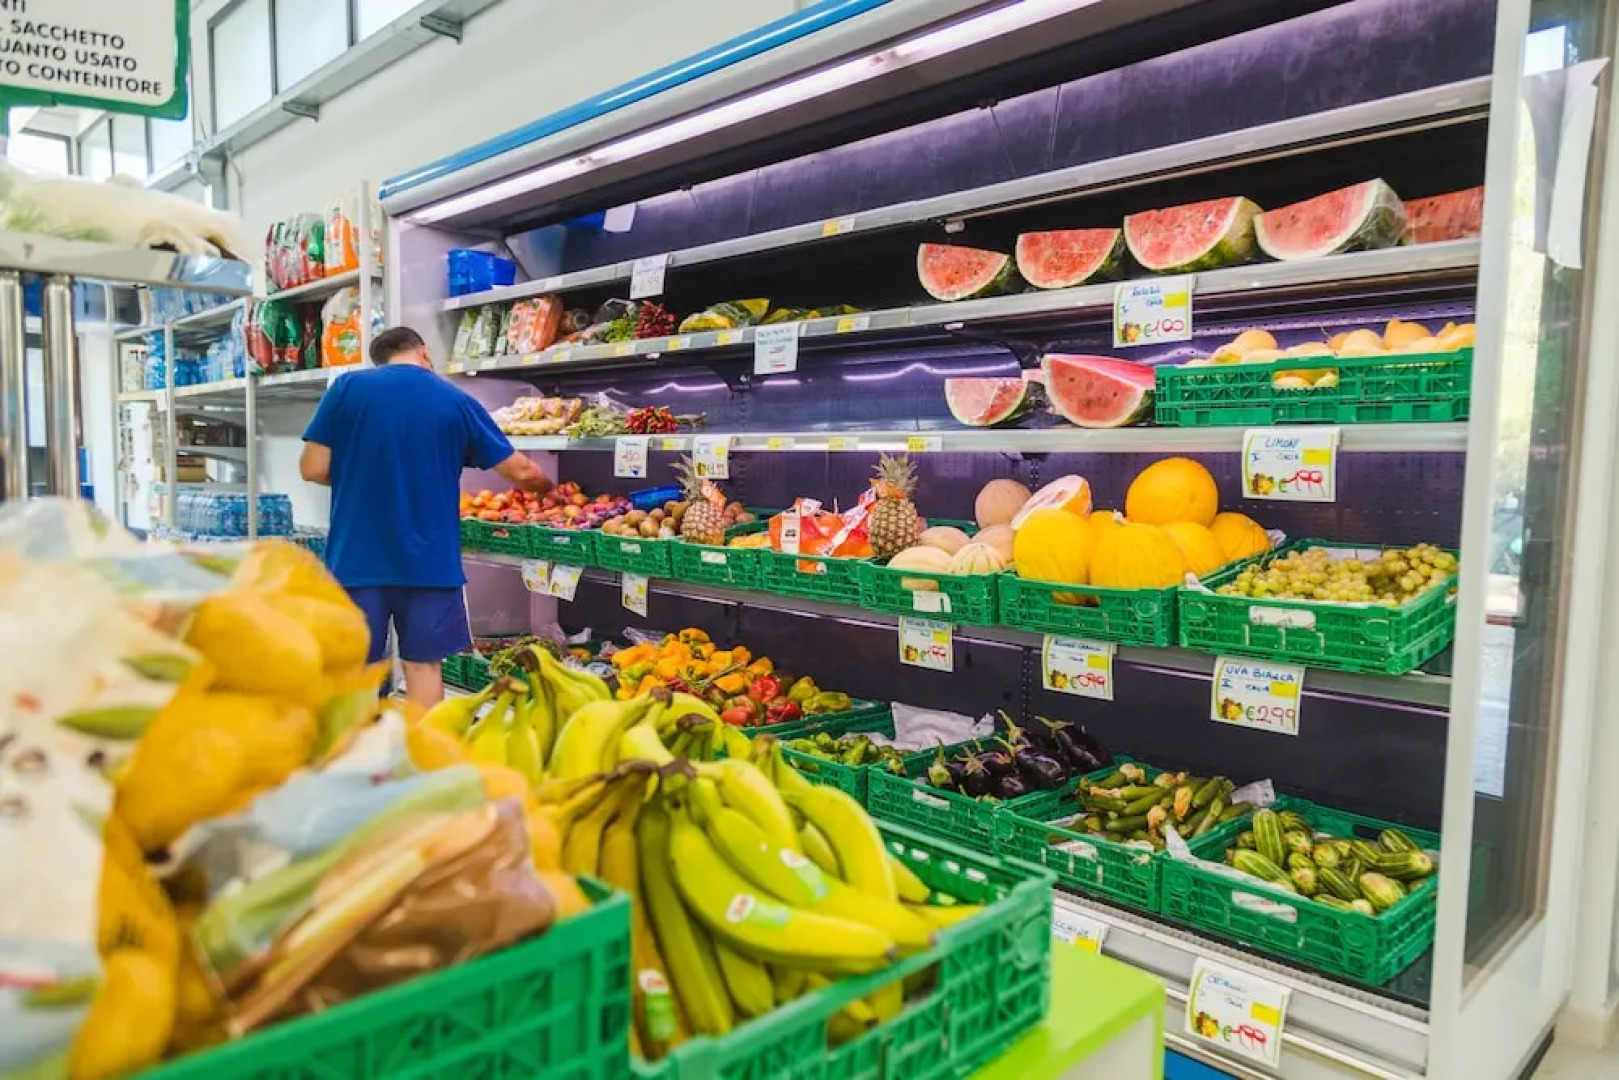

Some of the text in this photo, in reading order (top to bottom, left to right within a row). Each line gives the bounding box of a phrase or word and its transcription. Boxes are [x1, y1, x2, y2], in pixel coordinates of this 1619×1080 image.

[11, 18, 125, 50] SACCHETTO
[75, 50, 137, 72] USATO
[27, 63, 163, 97] CONTENITORE
[1225, 666, 1248, 676] UVA
